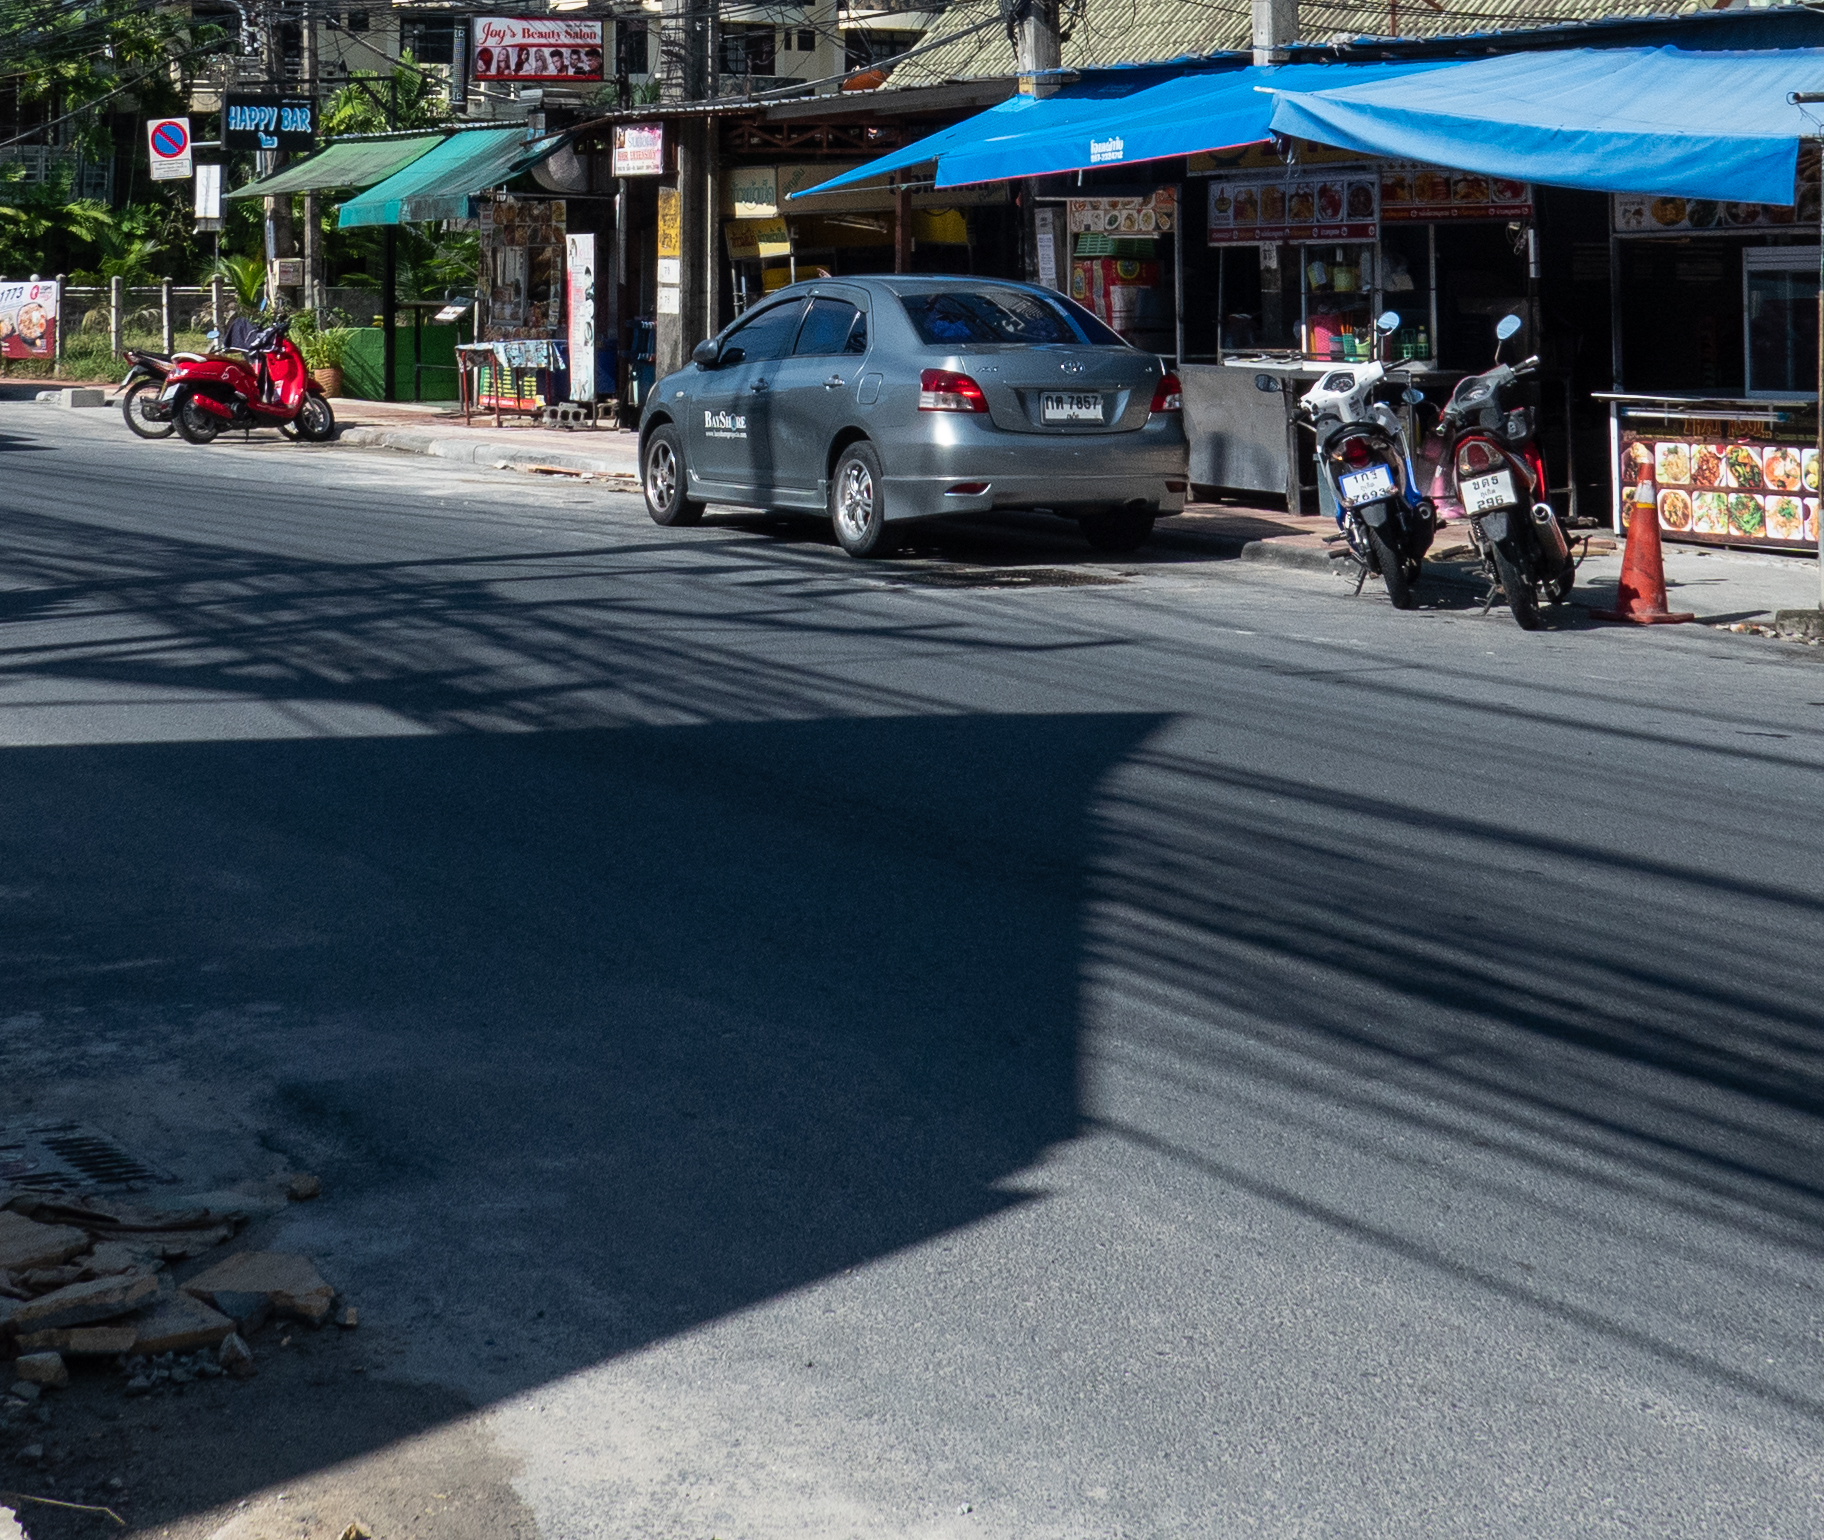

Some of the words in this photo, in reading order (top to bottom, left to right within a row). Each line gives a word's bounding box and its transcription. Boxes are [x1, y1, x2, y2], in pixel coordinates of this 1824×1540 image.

[478, 21, 517, 46] Joy's
[522, 28, 561, 42] Beauty
[564, 28, 597, 40] Salon
[229, 106, 278, 131] HAPPY
[281, 107, 312, 133] BAR
[0, 286, 24, 302] 1773
[1068, 395, 1098, 410] 7857
[1353, 488, 1387, 503] 7693
[1477, 495, 1504, 510] 296
